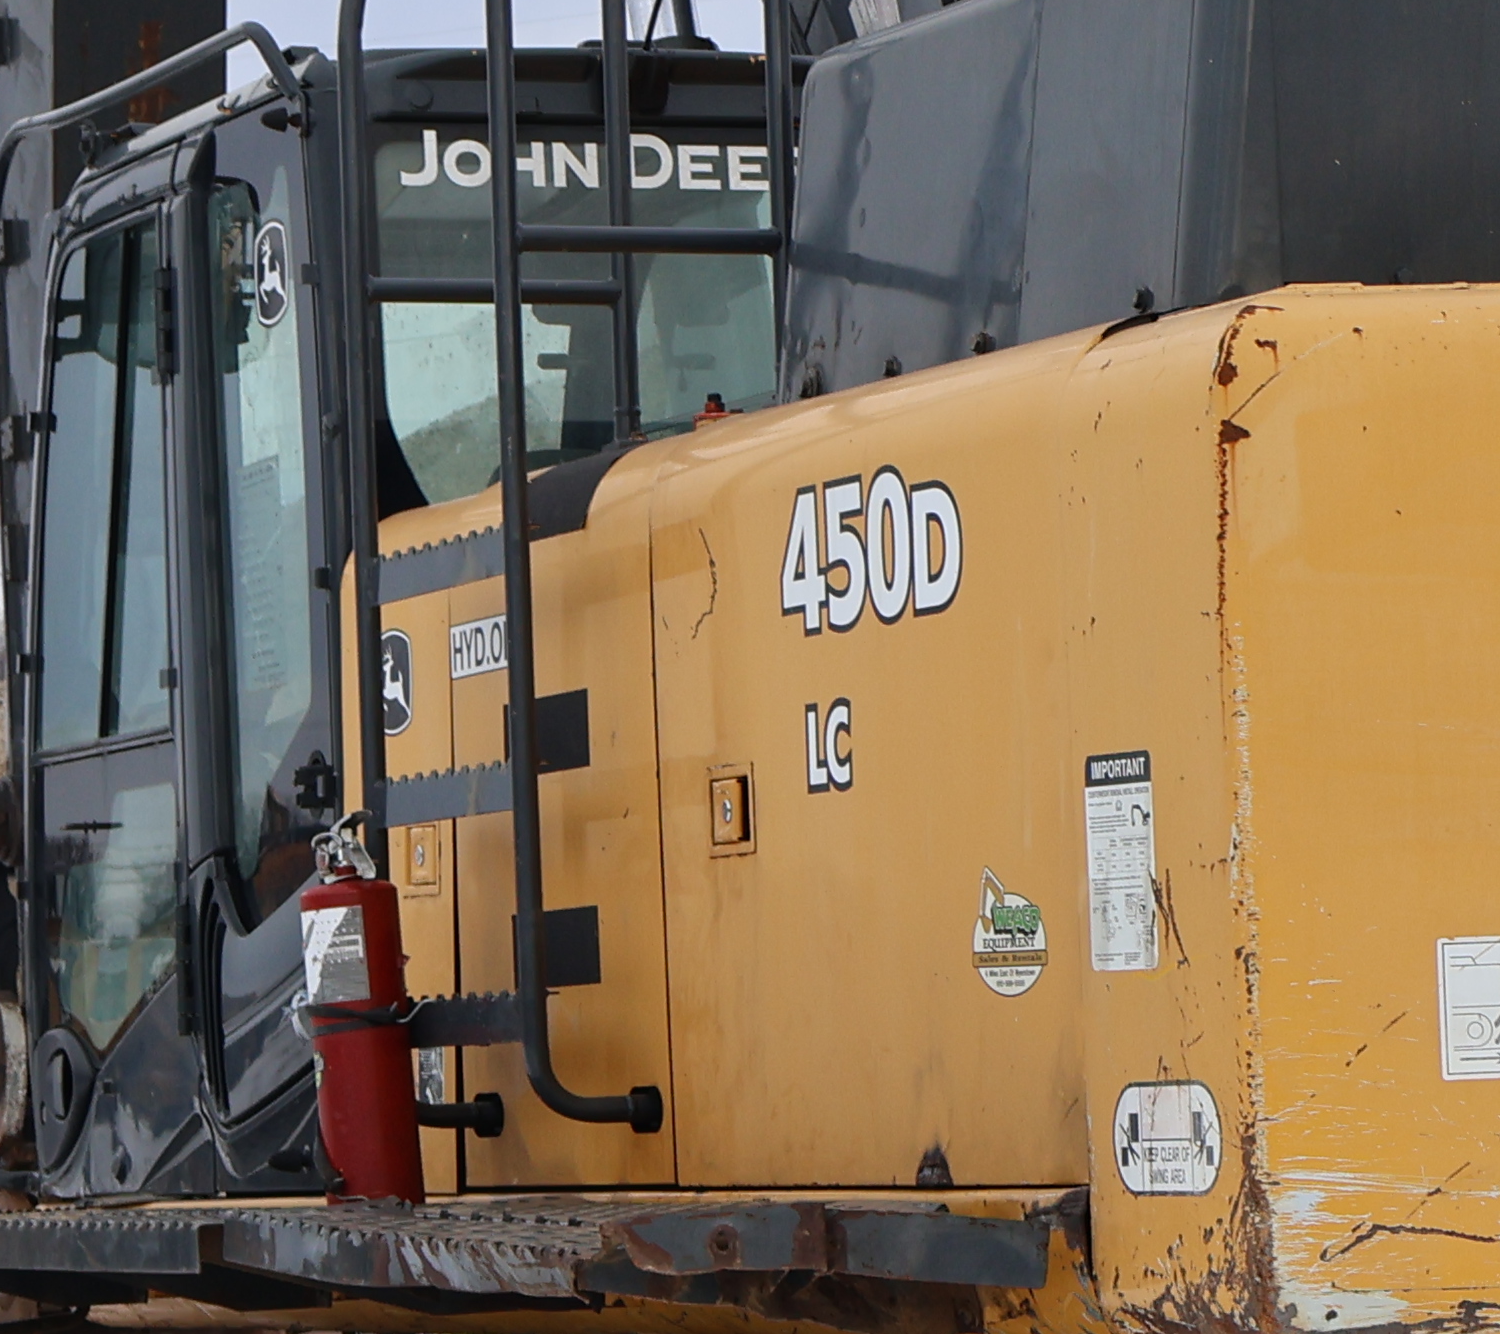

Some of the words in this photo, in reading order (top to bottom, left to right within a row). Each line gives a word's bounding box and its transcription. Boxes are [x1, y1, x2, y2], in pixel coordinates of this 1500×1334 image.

[630, 133, 798, 191] DEE
[782, 465, 962, 636] 450D
[805, 698, 852, 793] LC
[1091, 757, 1145, 780] IMPORTANT
[1161, 1146, 1180, 1163] CLEAR
[1181, 1147, 1190, 1162] OF
[1170, 1168, 1186, 1184] AREA
